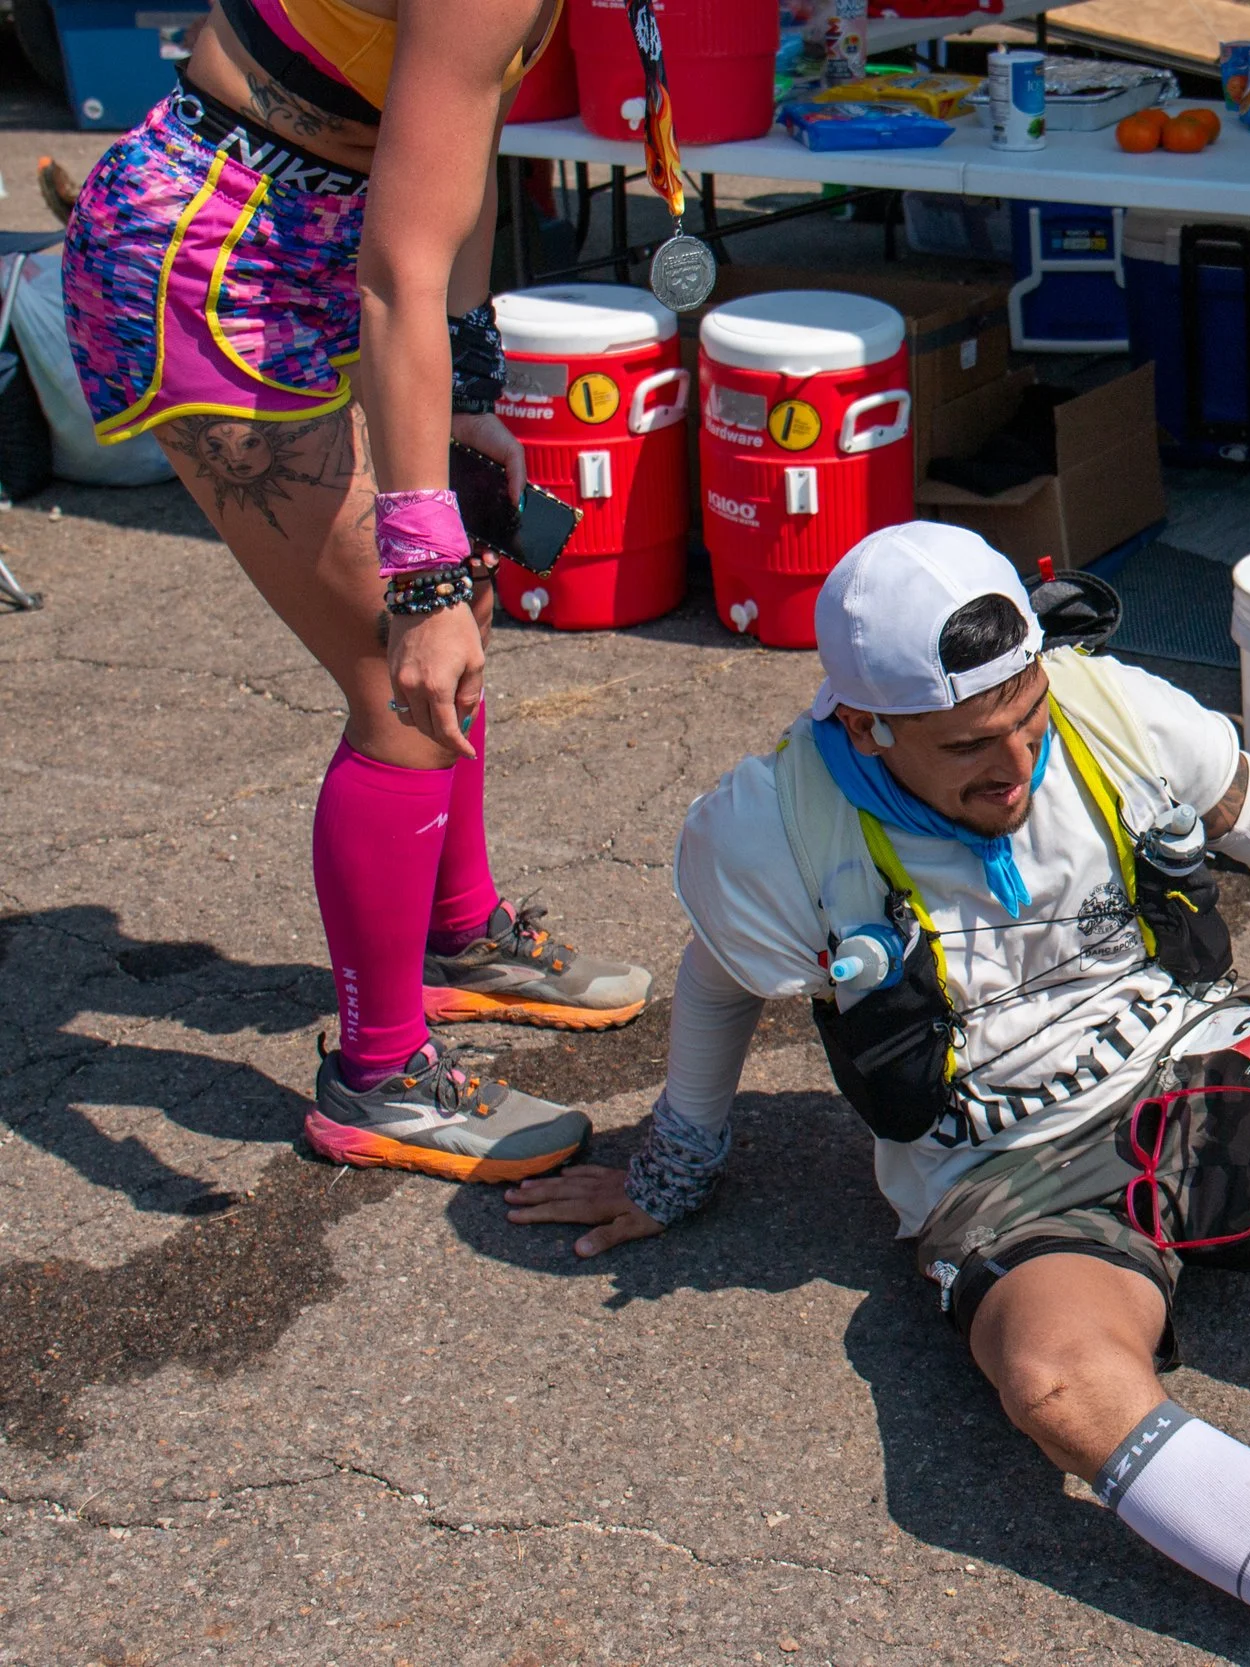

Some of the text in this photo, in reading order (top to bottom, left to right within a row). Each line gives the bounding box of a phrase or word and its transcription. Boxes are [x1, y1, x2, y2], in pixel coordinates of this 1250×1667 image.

[216, 126, 353, 195] NIKE
[495, 402, 555, 420] ardware
[705, 416, 764, 448] Hardware
[707, 490, 756, 520] IGLOO
[1084, 946, 1111, 958] DARC
